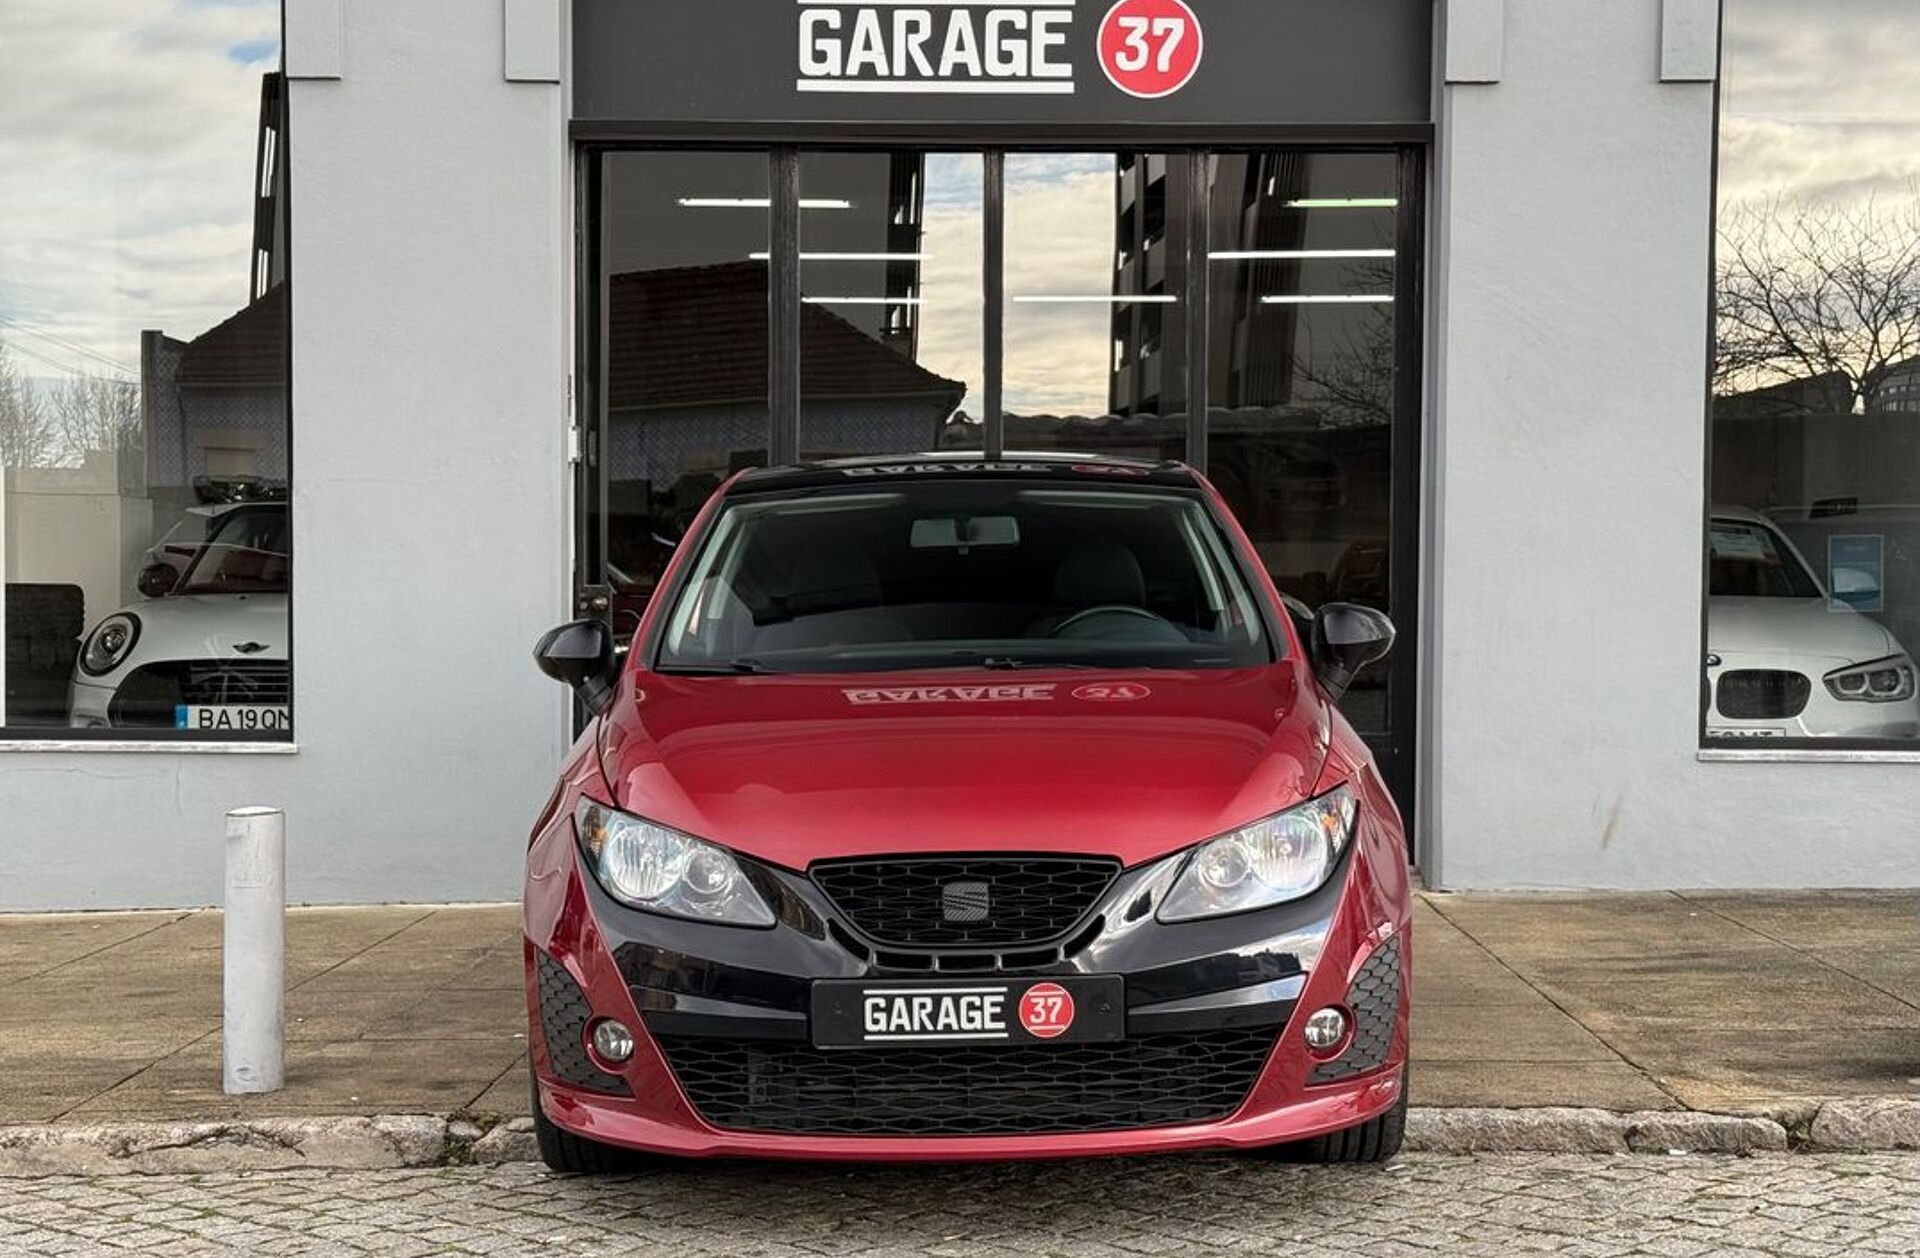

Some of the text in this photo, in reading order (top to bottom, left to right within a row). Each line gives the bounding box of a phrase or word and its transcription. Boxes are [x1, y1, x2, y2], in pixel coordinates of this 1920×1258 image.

[799, 9, 1185, 77] GARAGE 37
[864, 995, 1062, 1032] GARAGE 37
